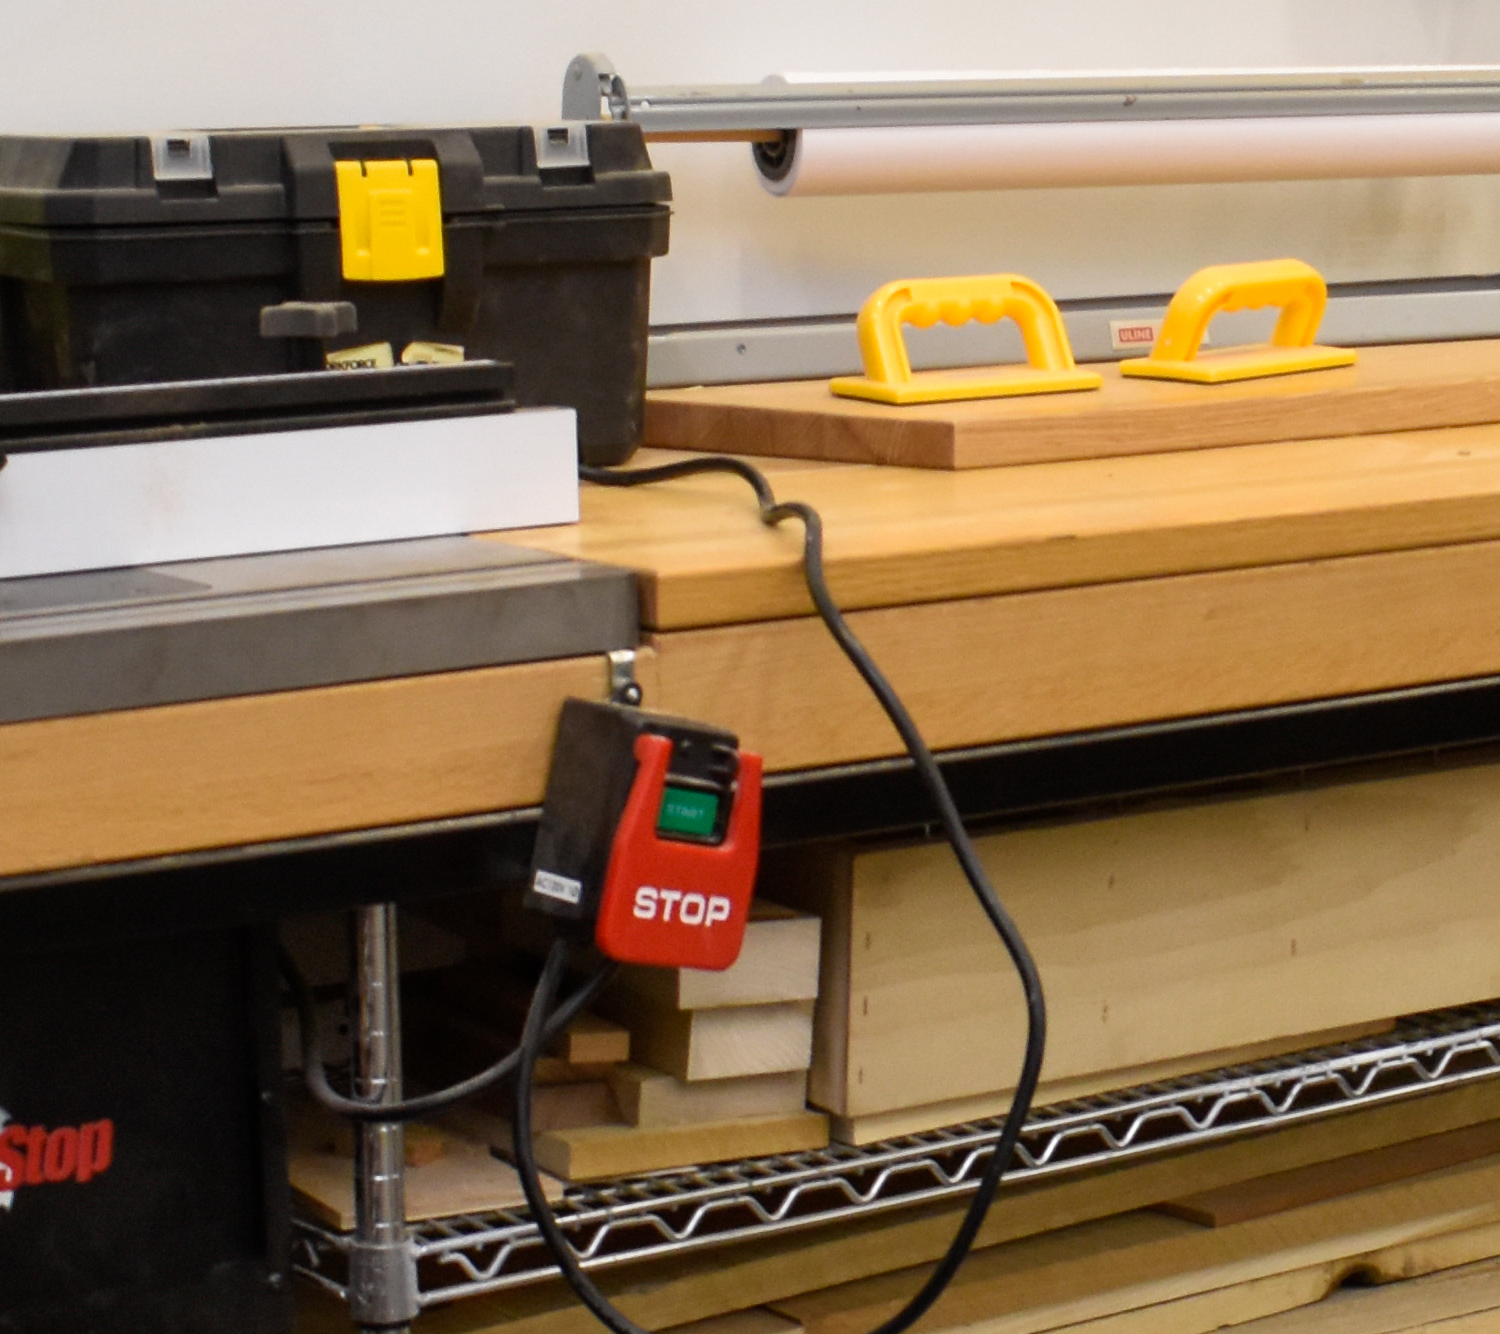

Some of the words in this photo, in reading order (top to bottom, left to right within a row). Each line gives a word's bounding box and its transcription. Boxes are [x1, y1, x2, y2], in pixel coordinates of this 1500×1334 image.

[1120, 327, 1152, 341] ULINE
[665, 802, 706, 819] START
[632, 885, 732, 928] STOP
